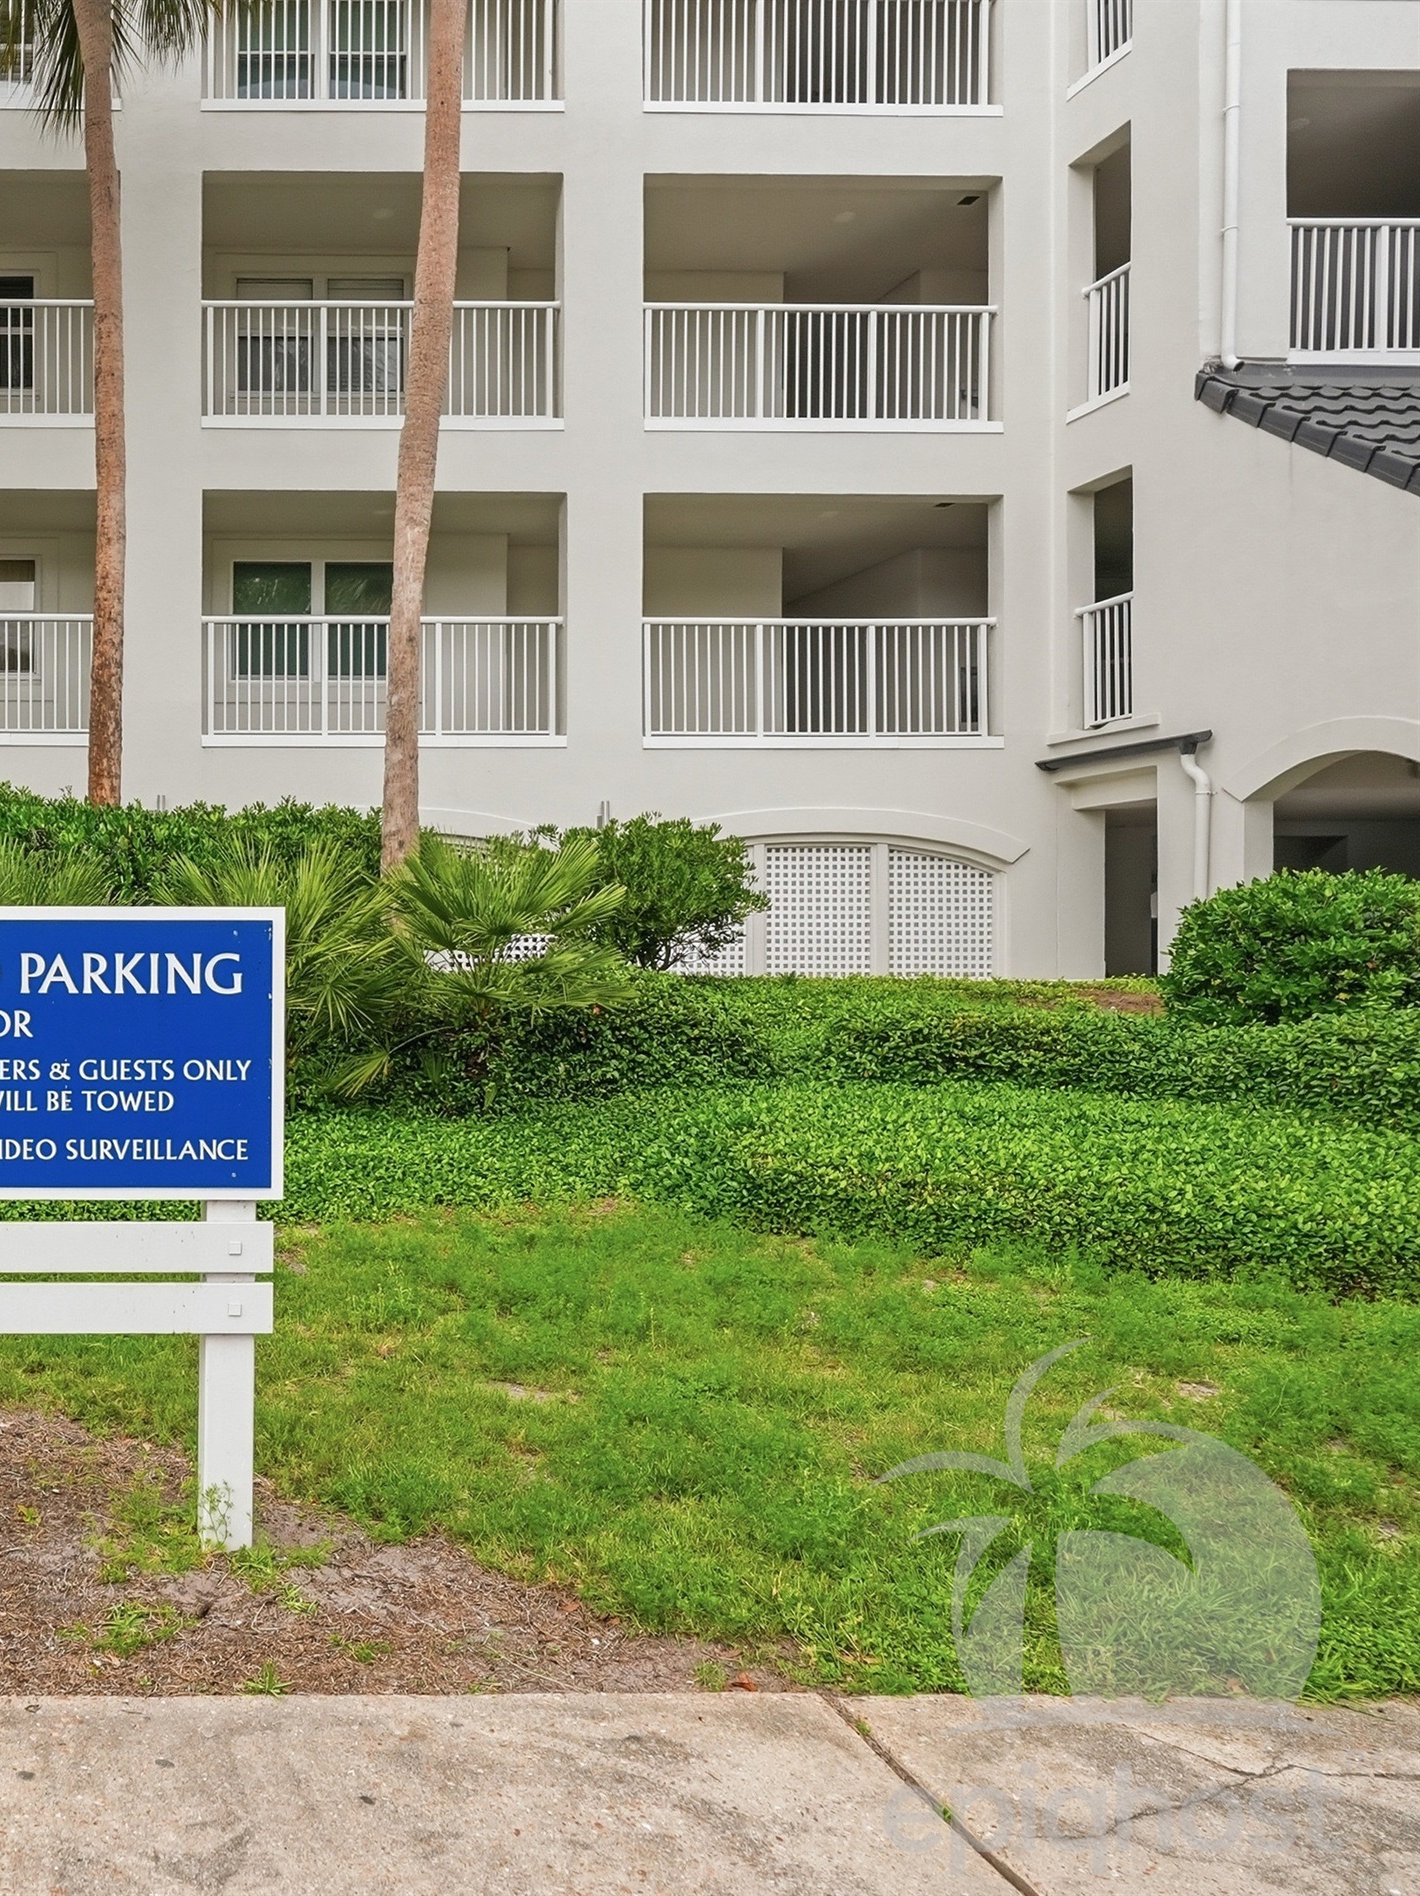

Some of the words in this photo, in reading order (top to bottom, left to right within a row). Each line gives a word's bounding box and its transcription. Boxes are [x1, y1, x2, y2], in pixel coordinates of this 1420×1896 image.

[20, 952, 243, 995] PARKING
[49, 1058, 71, 1081] &
[78, 1059, 175, 1081] GUESTS
[182, 1059, 252, 1081] ONLY
[46, 1090, 73, 1112] BE
[81, 1090, 175, 1112] TOWED
[65, 1138, 249, 1161] SURVEILLANCE
